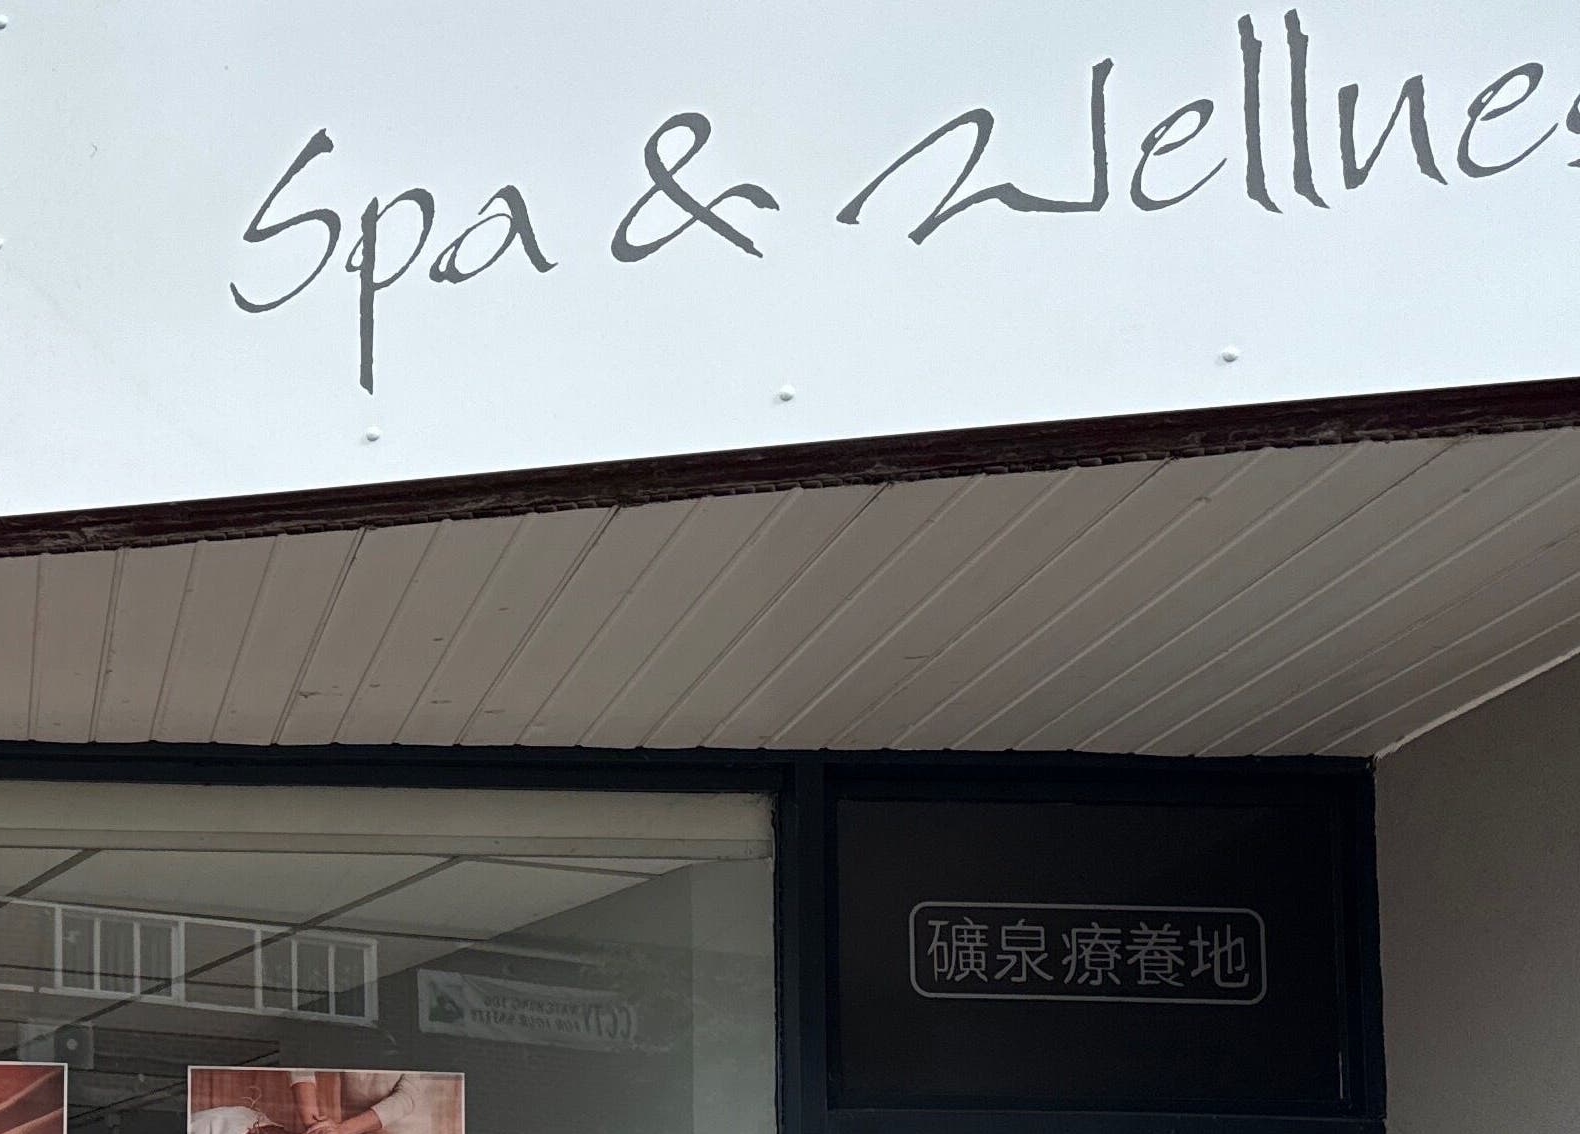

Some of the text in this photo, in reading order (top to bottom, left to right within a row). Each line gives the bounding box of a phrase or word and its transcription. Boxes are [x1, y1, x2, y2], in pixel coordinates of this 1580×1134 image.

[230, 8, 1580, 395] Spa & Wellne
[927, 916, 1250, 989] 礦泉療養地
